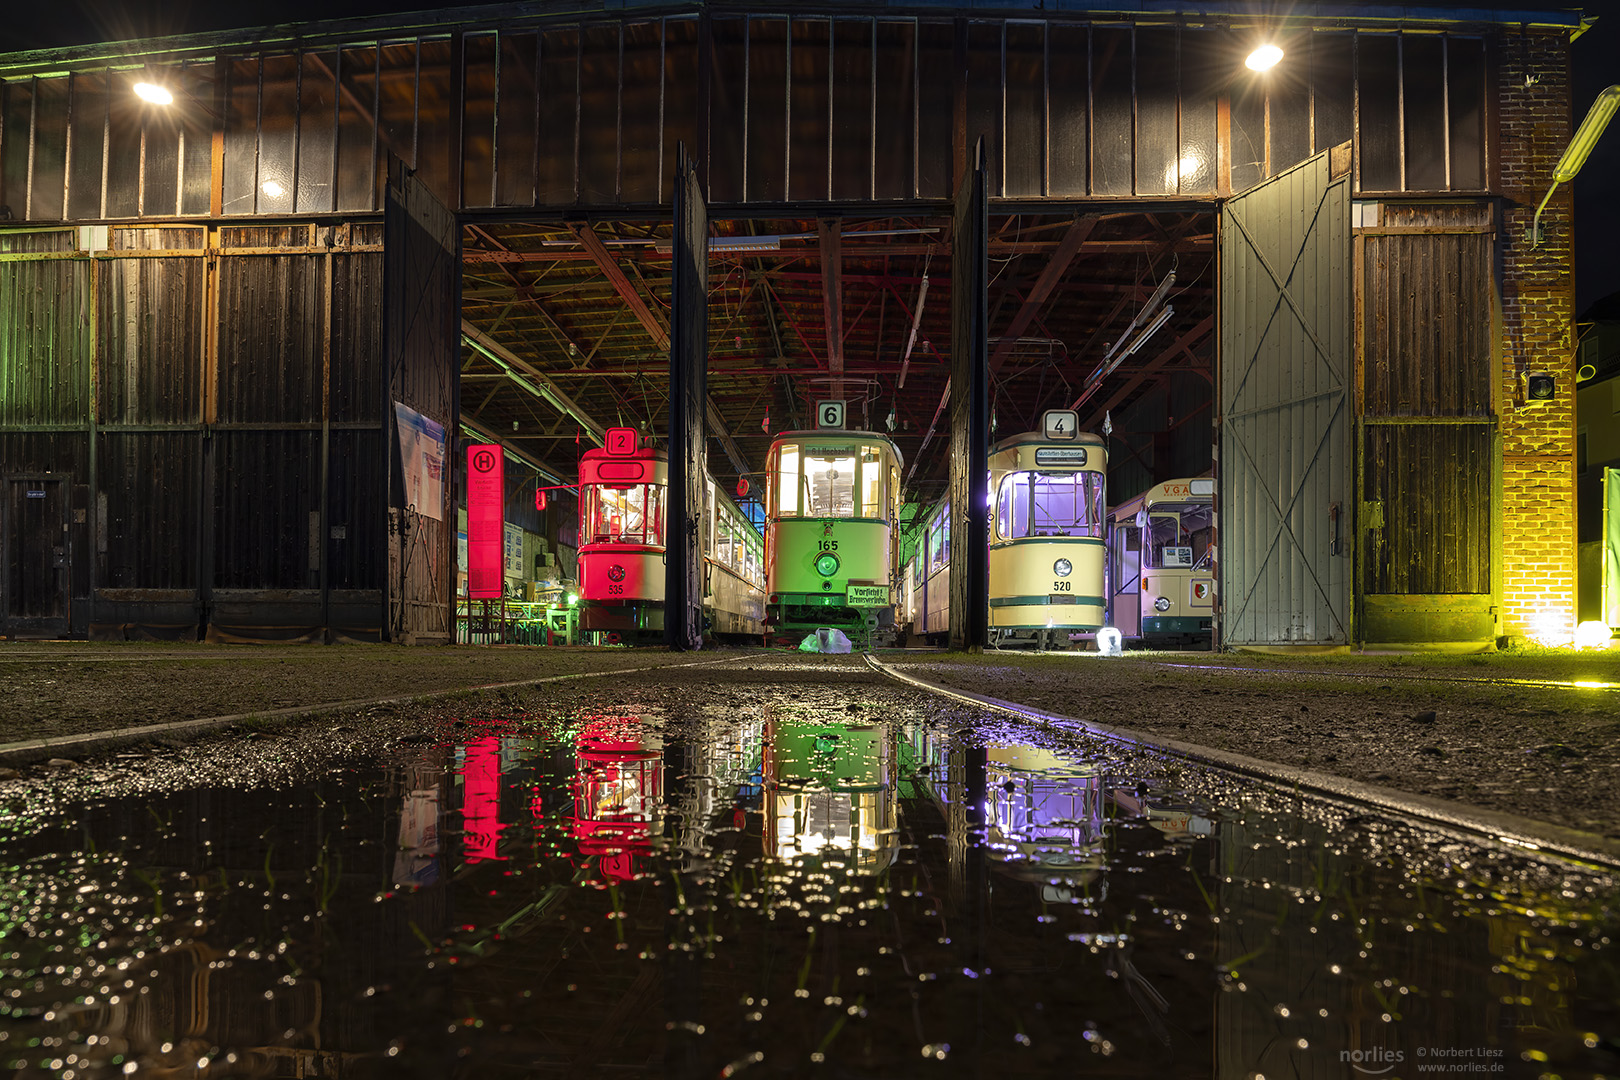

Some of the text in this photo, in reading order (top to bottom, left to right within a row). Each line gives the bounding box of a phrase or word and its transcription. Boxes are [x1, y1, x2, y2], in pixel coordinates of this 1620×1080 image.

[823, 406, 838, 424] 6
[1054, 417, 1065, 435] 4
[617, 435, 626, 448] 2
[478, 455, 490, 468] H
[817, 540, 838, 551] 165
[608, 584, 624, 595] 535
[1053, 581, 1071, 592] 520
